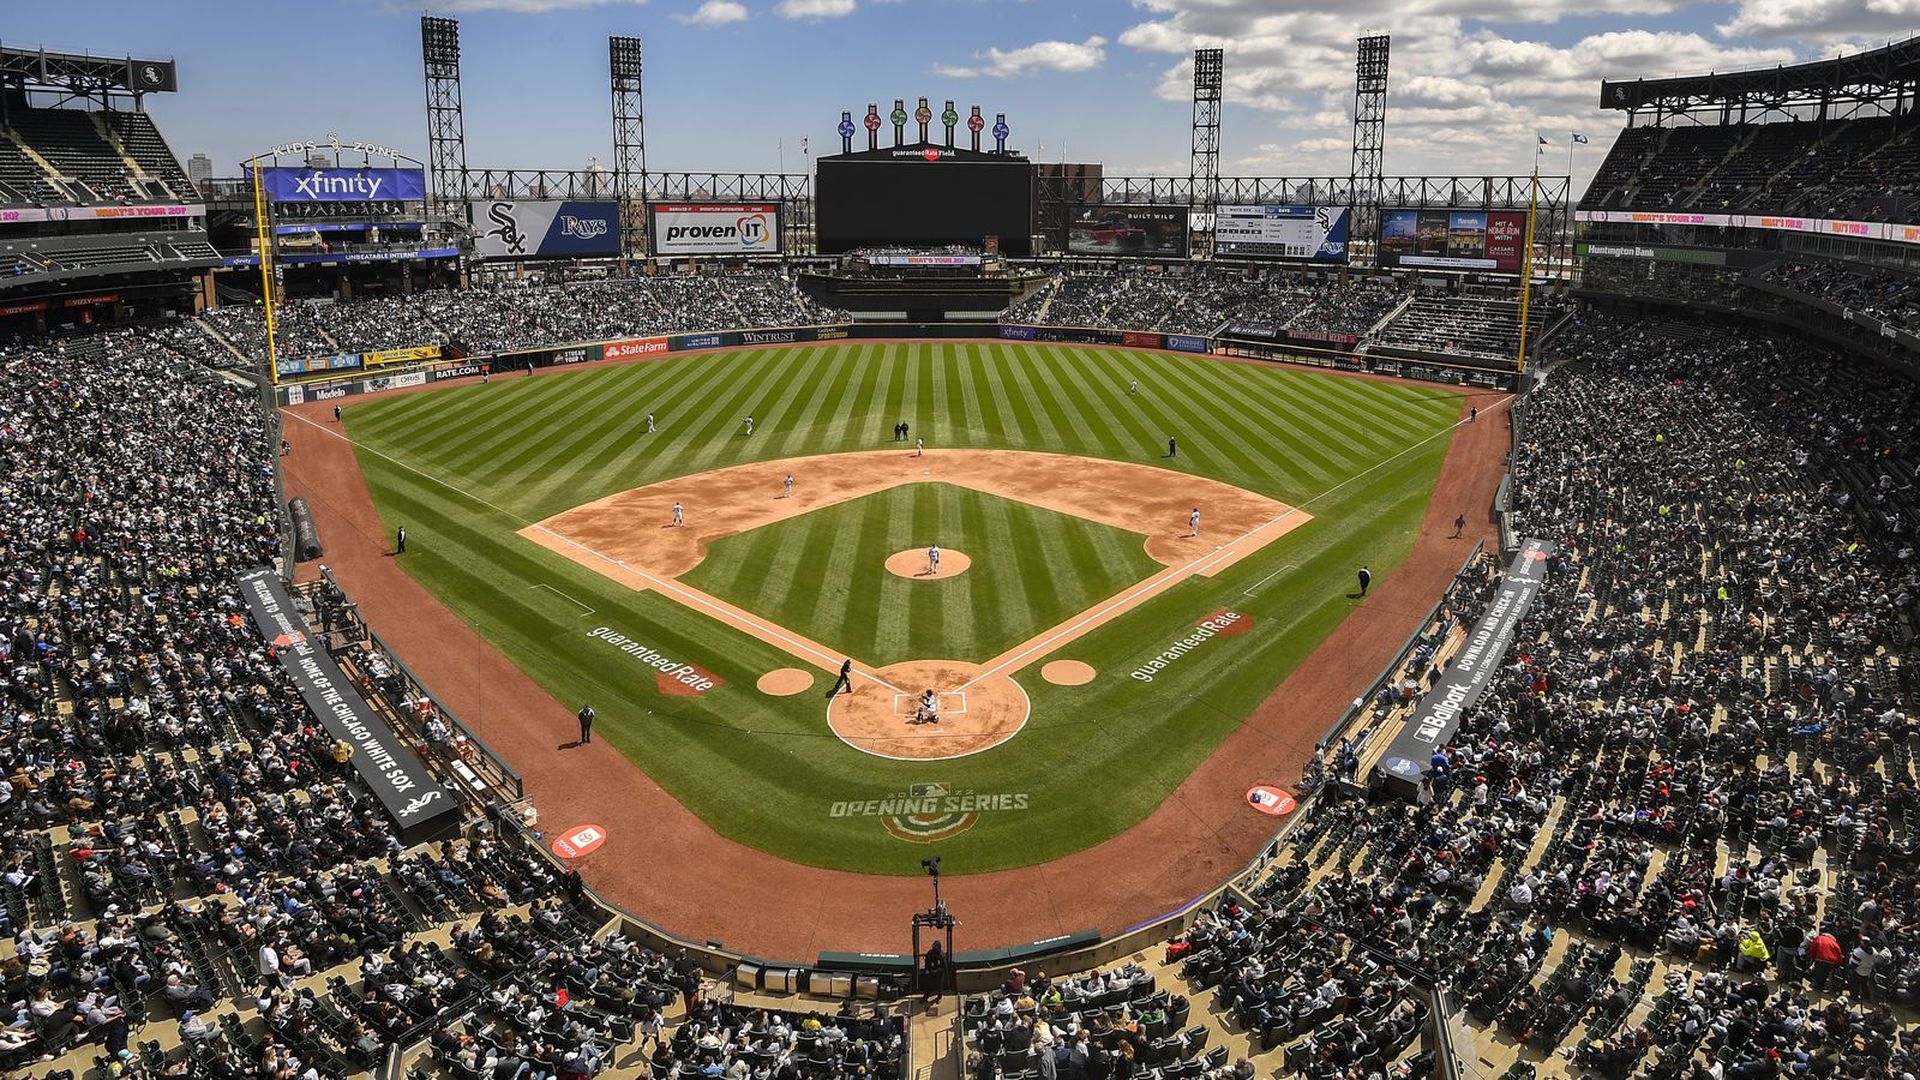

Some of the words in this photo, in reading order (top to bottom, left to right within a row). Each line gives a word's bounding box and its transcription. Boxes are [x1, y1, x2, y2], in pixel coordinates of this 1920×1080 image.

[272, 141, 317, 159] KIDS
[353, 141, 401, 161] ZONE
[295, 171, 382, 199] xfinity
[95, 207, 135, 217] WHAT'S
[136, 207, 166, 217] YOUR
[167, 206, 187, 216] 20?
[1631, 213, 1665, 222] WHAT'S
[1666, 214, 1690, 223] YOUR
[1690, 215, 1705, 224] 20?
[666, 225, 737, 242] proven
[745, 224, 761, 237] IT
[389, 251, 419, 259] INTERNET
[1588, 245, 1634, 258] Huntington
[1635, 247, 1655, 258] Bank
[743, 332, 796, 344] WINTRUST
[1003, 329, 1029, 338] xfinity
[400, 374, 421, 385] ORIS
[436, 366, 479, 380] RATE.COM
[316, 388, 346, 401] Modelo
[1457, 630, 1492, 672] DOWNLOAD
[1482, 616, 1500, 633] AND
[298, 657, 325, 680] HOME
[313, 677, 332, 689] OF
[320, 687, 344, 706] THE
[1422, 683, 1473, 729] Ballpark
[331, 702, 372, 741] CHICAGO
[361, 738, 398, 772] WHITE
[385, 769, 416, 793] SOX
[829, 798, 939, 818] OPENING
[944, 793, 1029, 813] SERIES
[555, 838, 578, 859] TOYOTA
